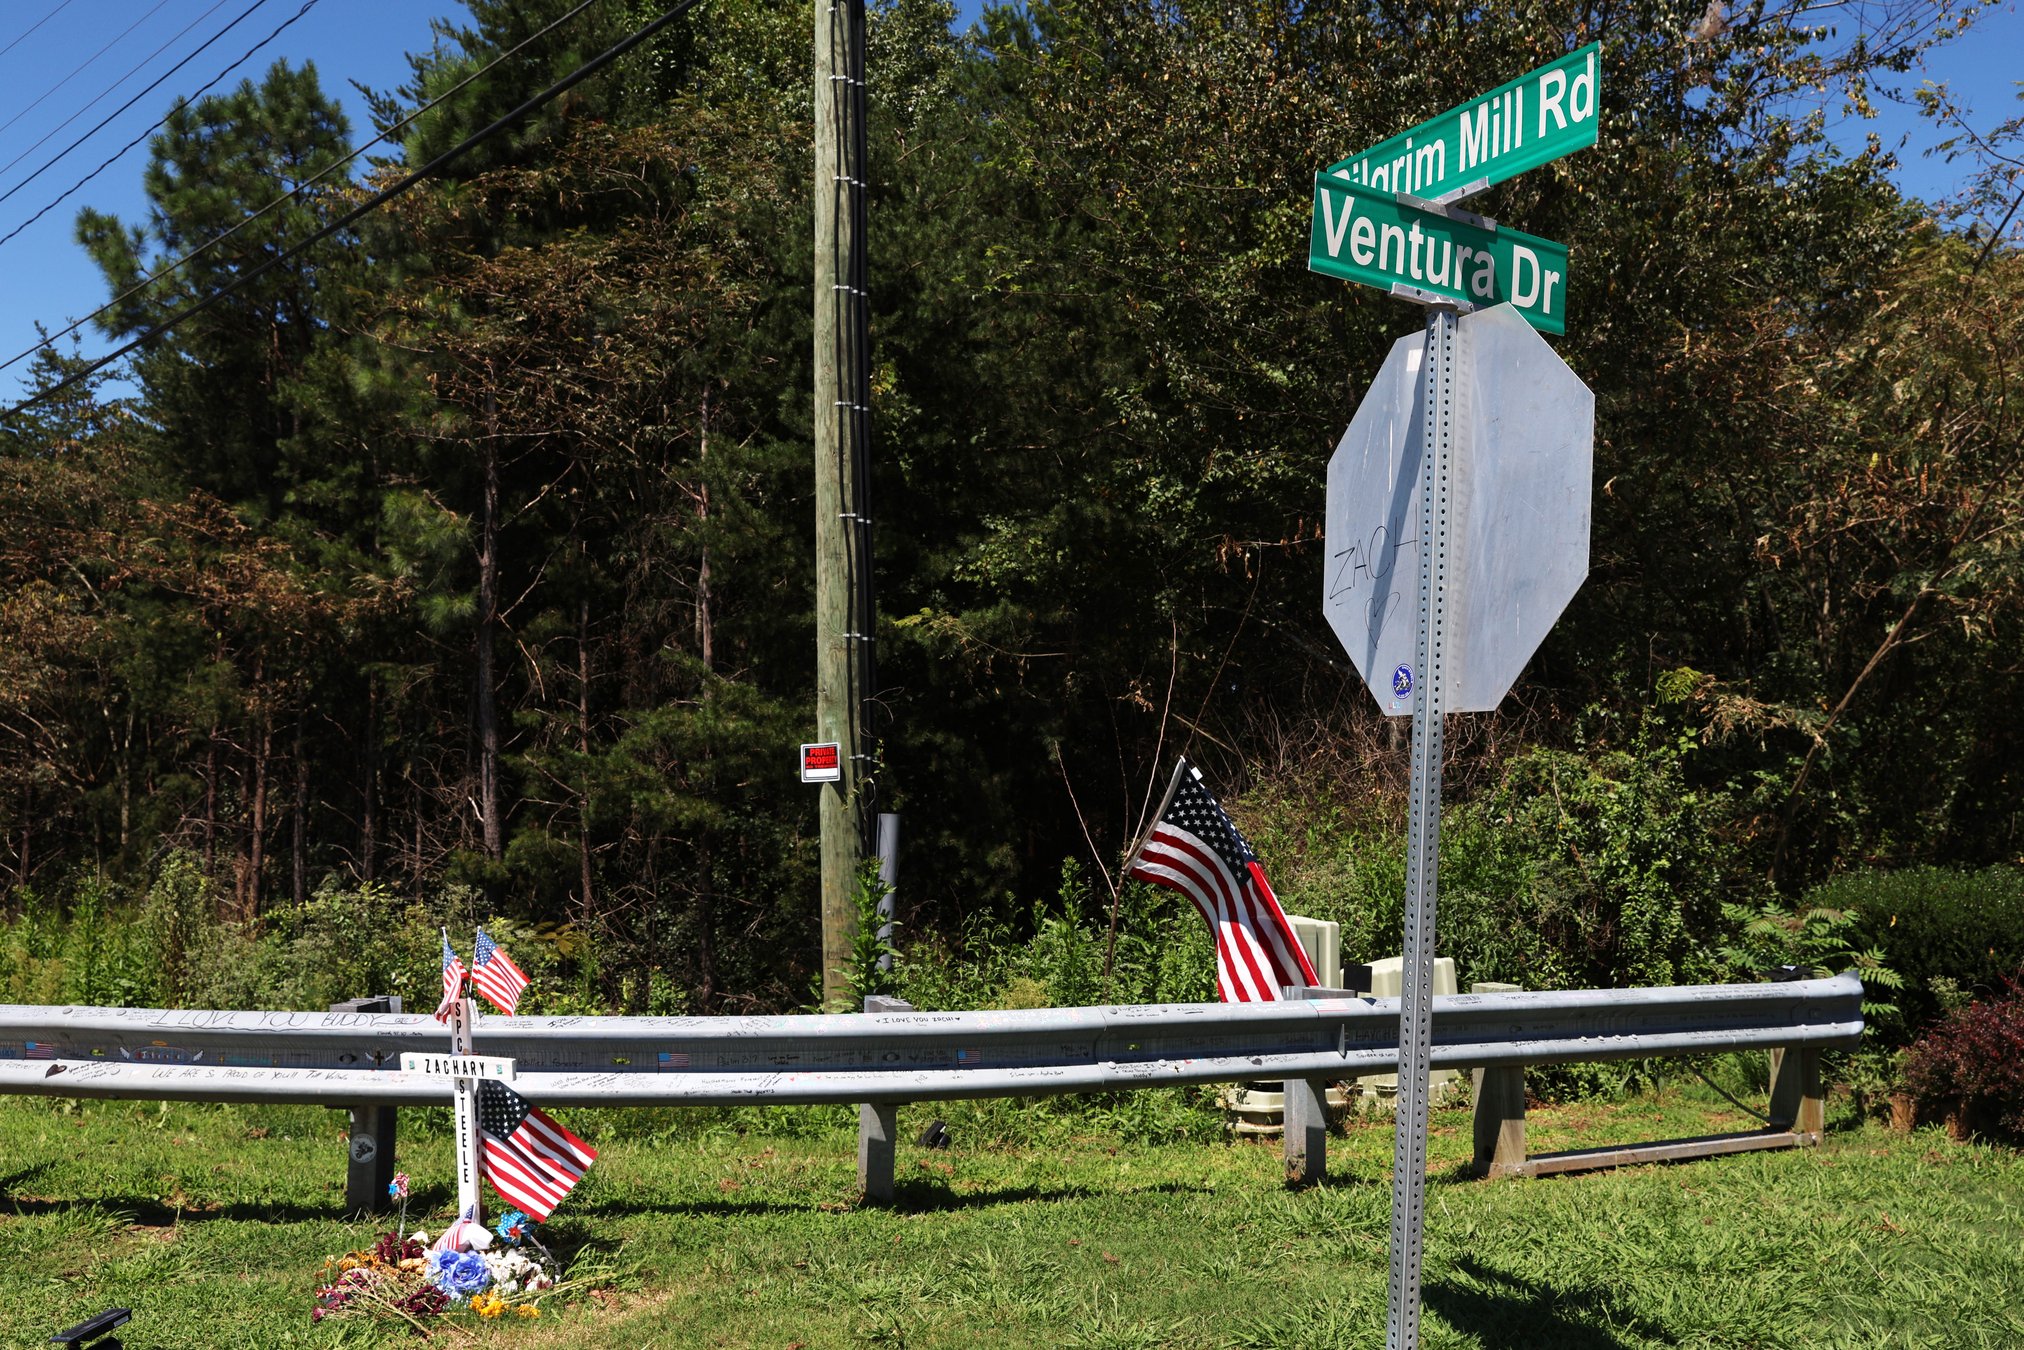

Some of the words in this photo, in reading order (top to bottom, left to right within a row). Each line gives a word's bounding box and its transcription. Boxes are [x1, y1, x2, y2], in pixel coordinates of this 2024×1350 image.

[1331, 137, 1446, 195] lgrim
[1459, 86, 1522, 172] Mill
[1538, 51, 1595, 138] Rd
[1320, 187, 1495, 299] Ventura
[1511, 244, 1560, 314] Dr
[1329, 503, 1418, 600] ZACH
[150, 1009, 170, 1025] I
[178, 1009, 237, 1027] LOVE
[258, 1011, 309, 1027] YOU
[321, 1012, 387, 1028] BUDDY
[455, 1002, 463, 1053] SPC
[424, 1058, 485, 1077] ZACHARY
[459, 1079, 469, 1184] STEELE
